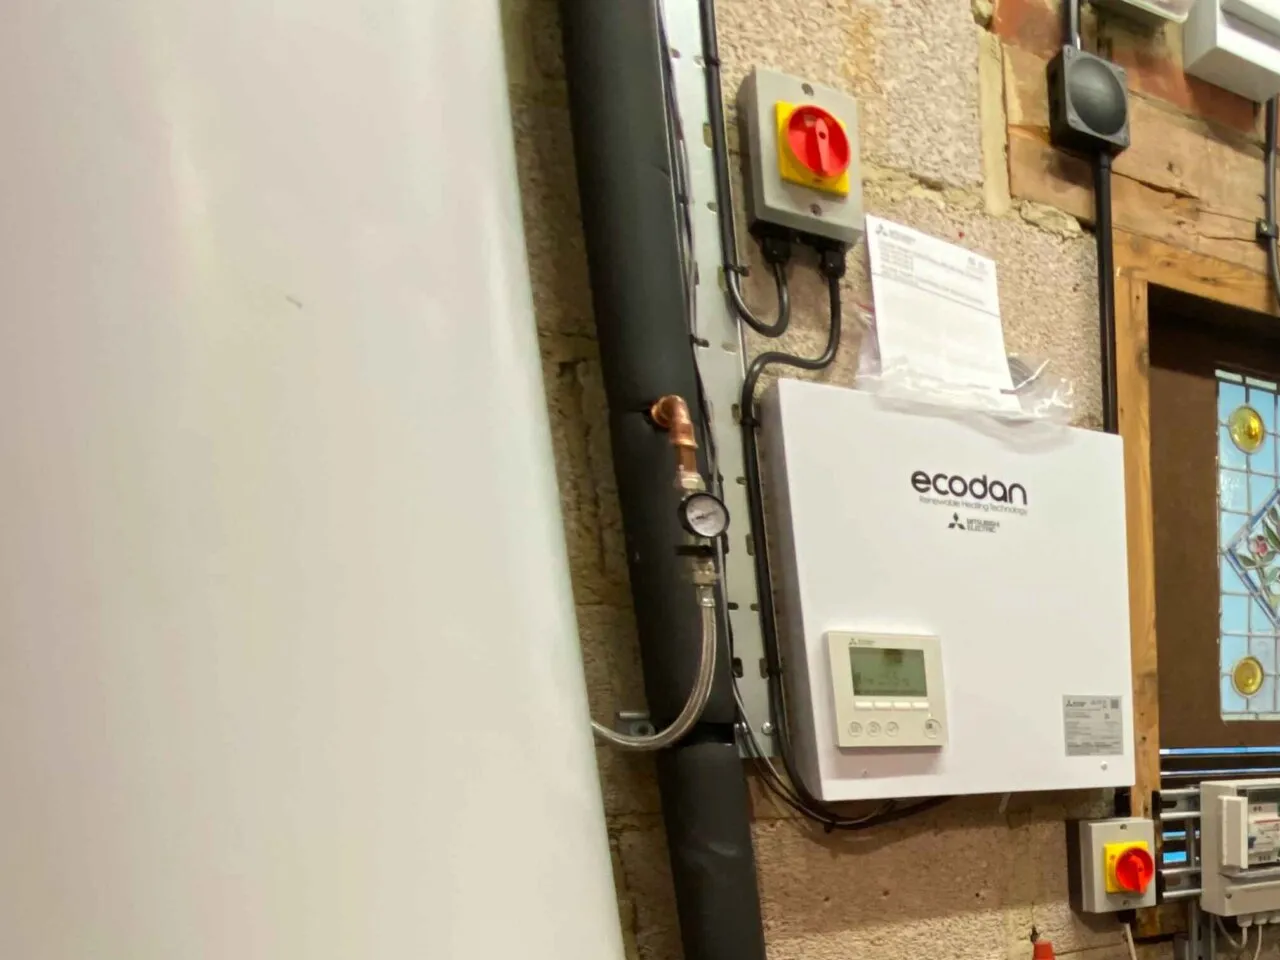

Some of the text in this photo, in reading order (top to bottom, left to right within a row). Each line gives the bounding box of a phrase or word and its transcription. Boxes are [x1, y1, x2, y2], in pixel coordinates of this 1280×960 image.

[911, 470, 1028, 505] ecodan
[962, 500, 990, 512] Heating
[990, 503, 1028, 516] Technology
